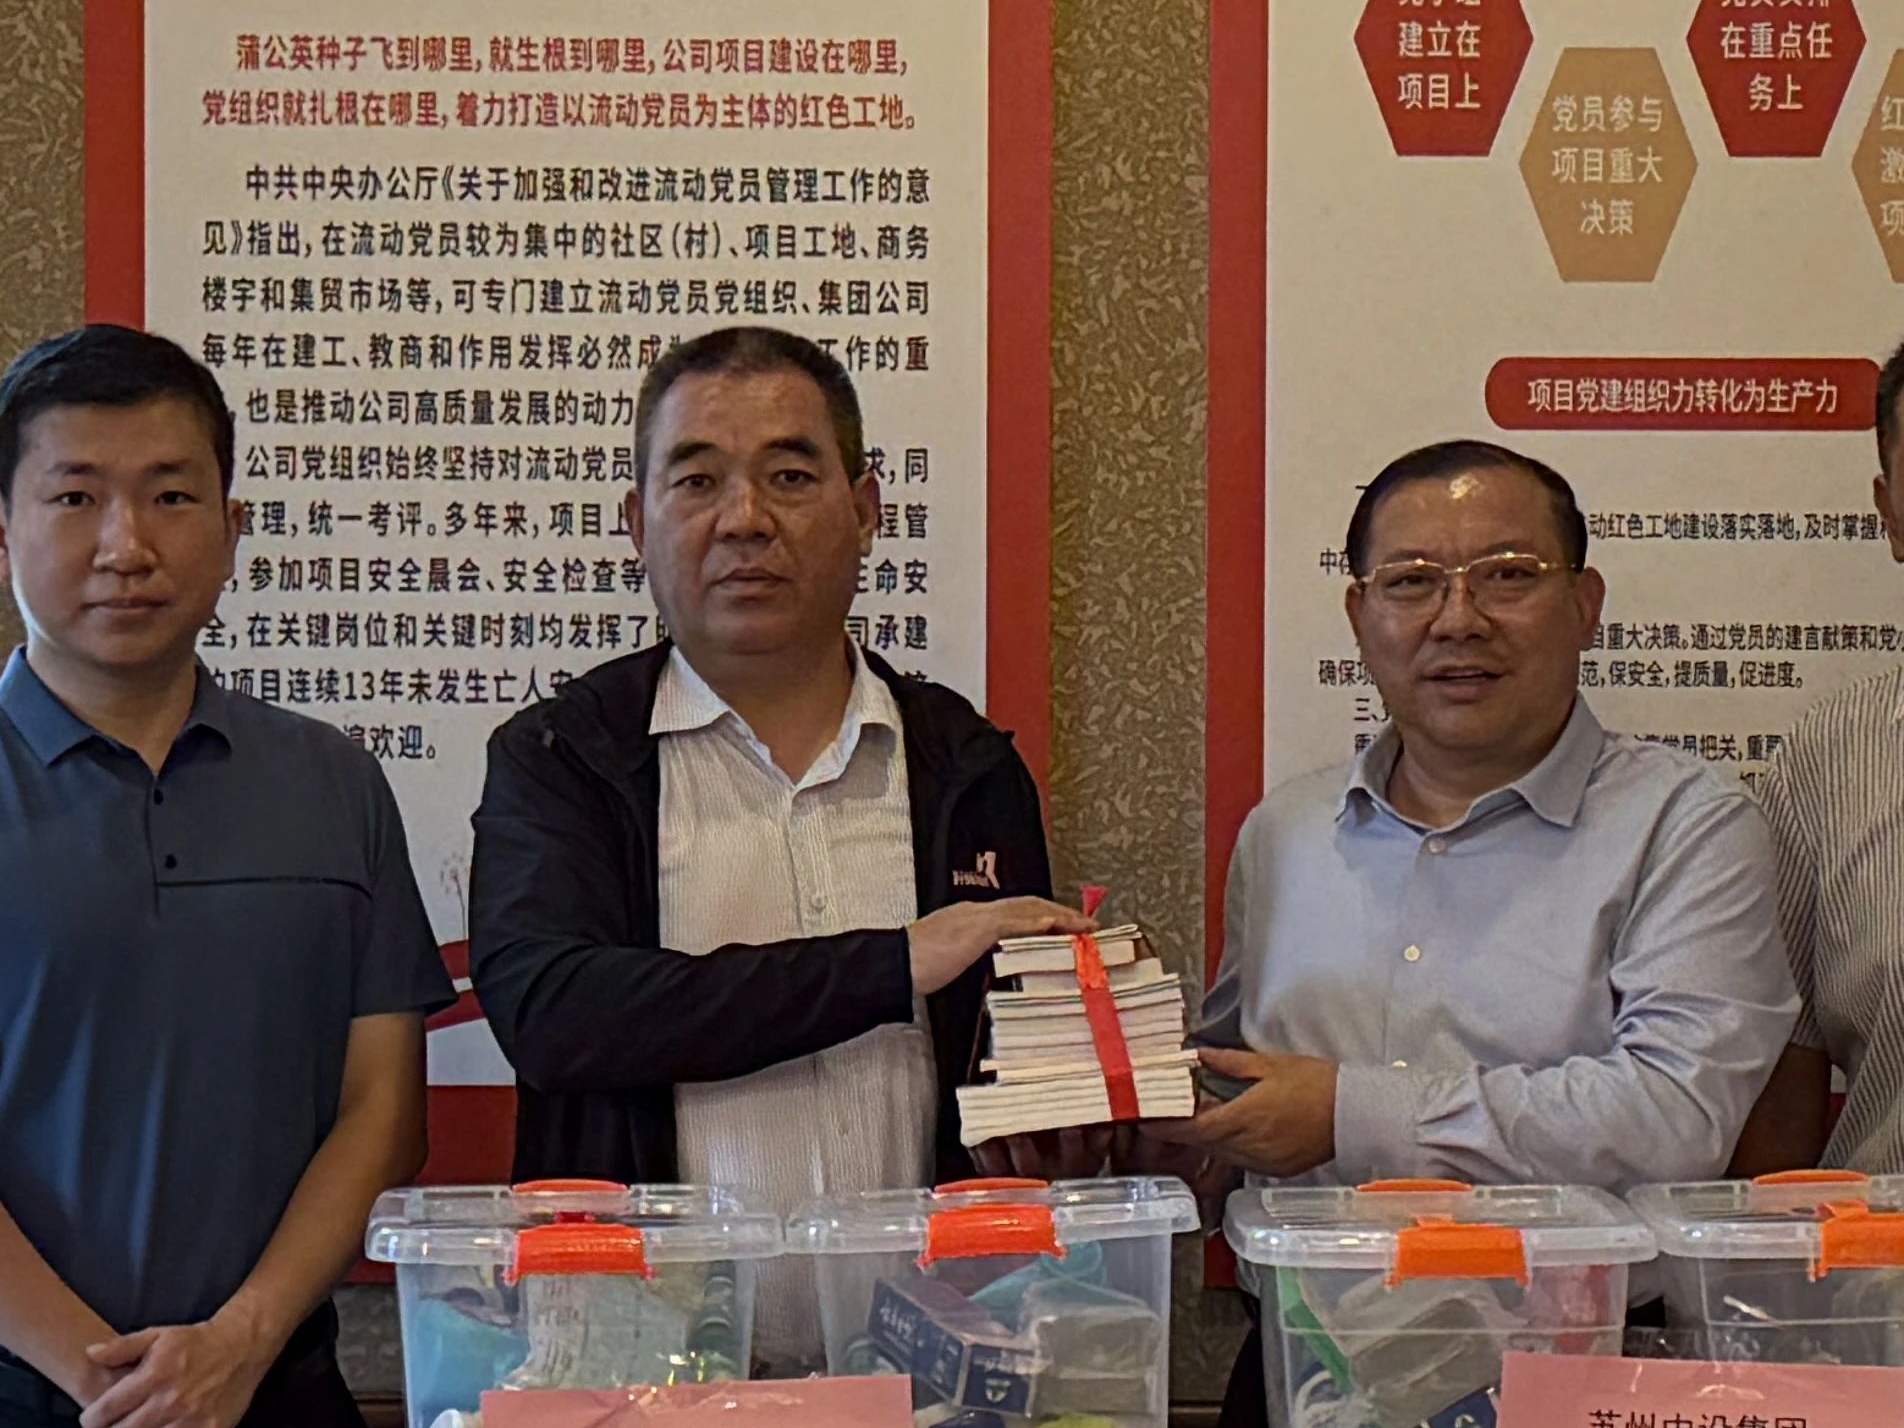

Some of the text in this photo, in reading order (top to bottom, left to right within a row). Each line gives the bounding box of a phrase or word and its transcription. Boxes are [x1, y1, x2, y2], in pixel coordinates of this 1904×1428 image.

[1397, 21, 1483, 61] 建立在
[1720, 21, 1834, 61] 在重点任
[1397, 73, 1482, 112] 项目上
[1748, 74, 1805, 113] 务上
[1551, 94, 1664, 135] 党员参与
[1551, 146, 1664, 186] 项目重大
[1579, 199, 1635, 238] 决策
[1527, 377, 1838, 417] 项目党建组织力转化为生产力
[1589, 513, 1887, 541] 动红色工地建设落实落地，及时掌握
